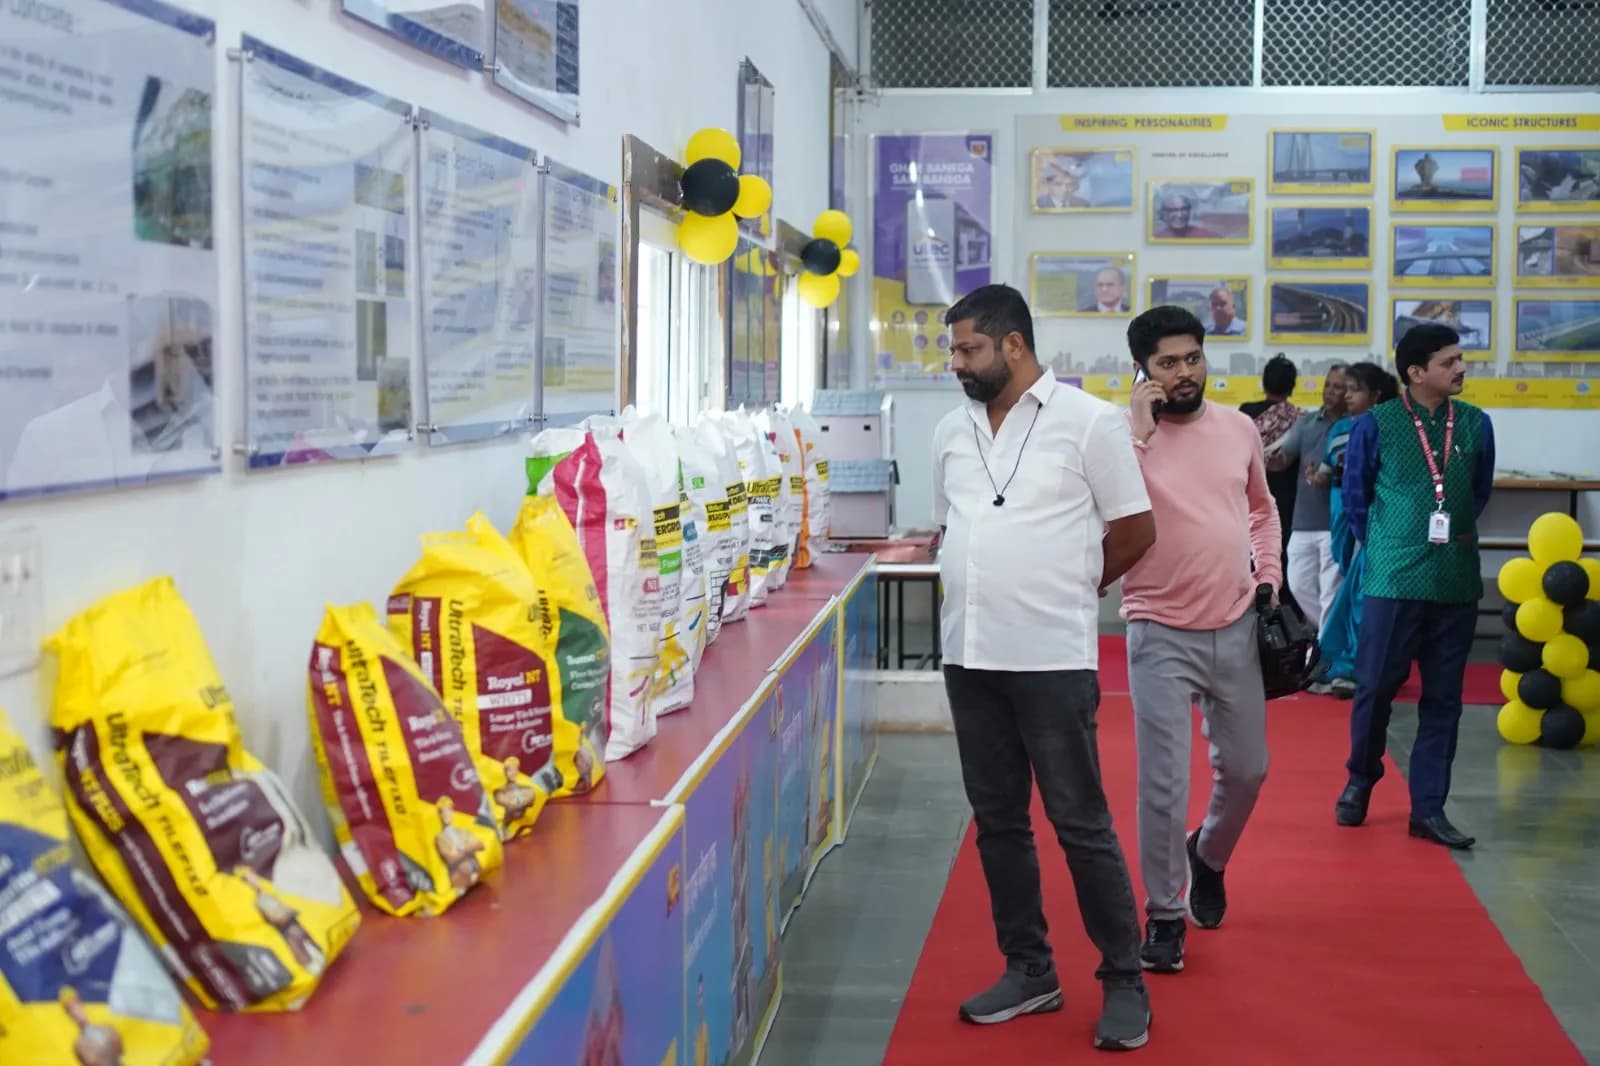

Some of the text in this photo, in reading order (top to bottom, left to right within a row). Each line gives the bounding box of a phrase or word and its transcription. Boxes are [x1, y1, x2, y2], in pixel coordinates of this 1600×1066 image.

[1074, 118, 1212, 128] INSPIRING PERSONALITIES
[1467, 118, 1577, 127] ICONIC STRUCTURES
[449, 600, 467, 691] UltraTech
[487, 672, 525, 690] Royal
